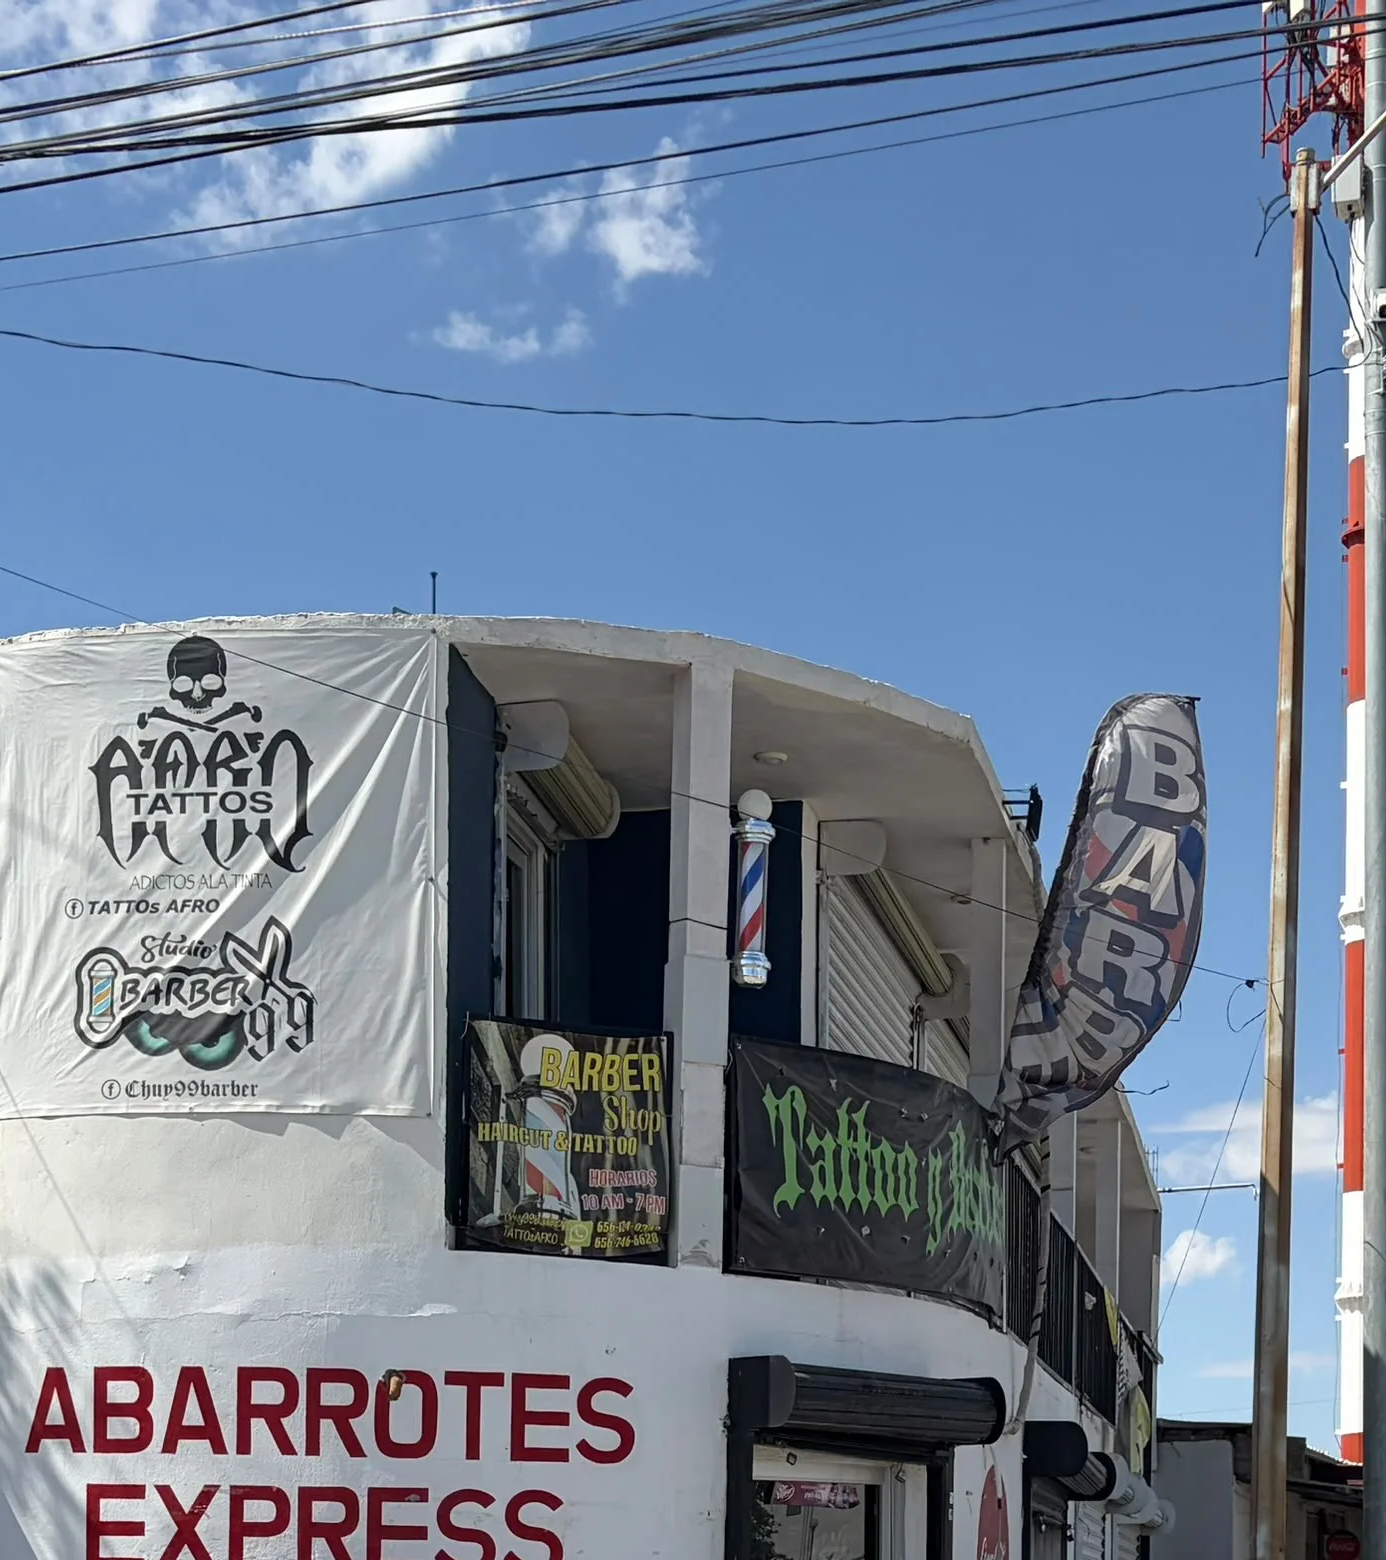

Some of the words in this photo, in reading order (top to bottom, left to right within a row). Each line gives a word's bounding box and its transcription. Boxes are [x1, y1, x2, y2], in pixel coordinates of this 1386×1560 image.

[126, 791, 273, 815] TATTOS
[129, 873, 194, 891] ADICTOS
[231, 873, 273, 890] TINTA
[165, 899, 220, 914] AFRO
[140, 932, 217, 963] Studio
[119, 976, 254, 1011] BARBER
[540, 1047, 662, 1092] BARBER
[125, 1079, 259, 1101] Chuy99barber
[603, 1095, 663, 1146] Shop
[478, 1122, 552, 1149] HAIRCUT
[554, 1133, 570, 1152] &
[572, 1133, 638, 1156] TATTOO
[762, 1081, 920, 1223] Tattoo
[589, 1168, 657, 1187] HORARIOS
[581, 1194, 599, 1210] 10
[601, 1193, 625, 1209] AM
[635, 1192, 645, 1211] 7
[646, 1194, 666, 1215] PM
[24, 1365, 637, 1464] ABARROTES
